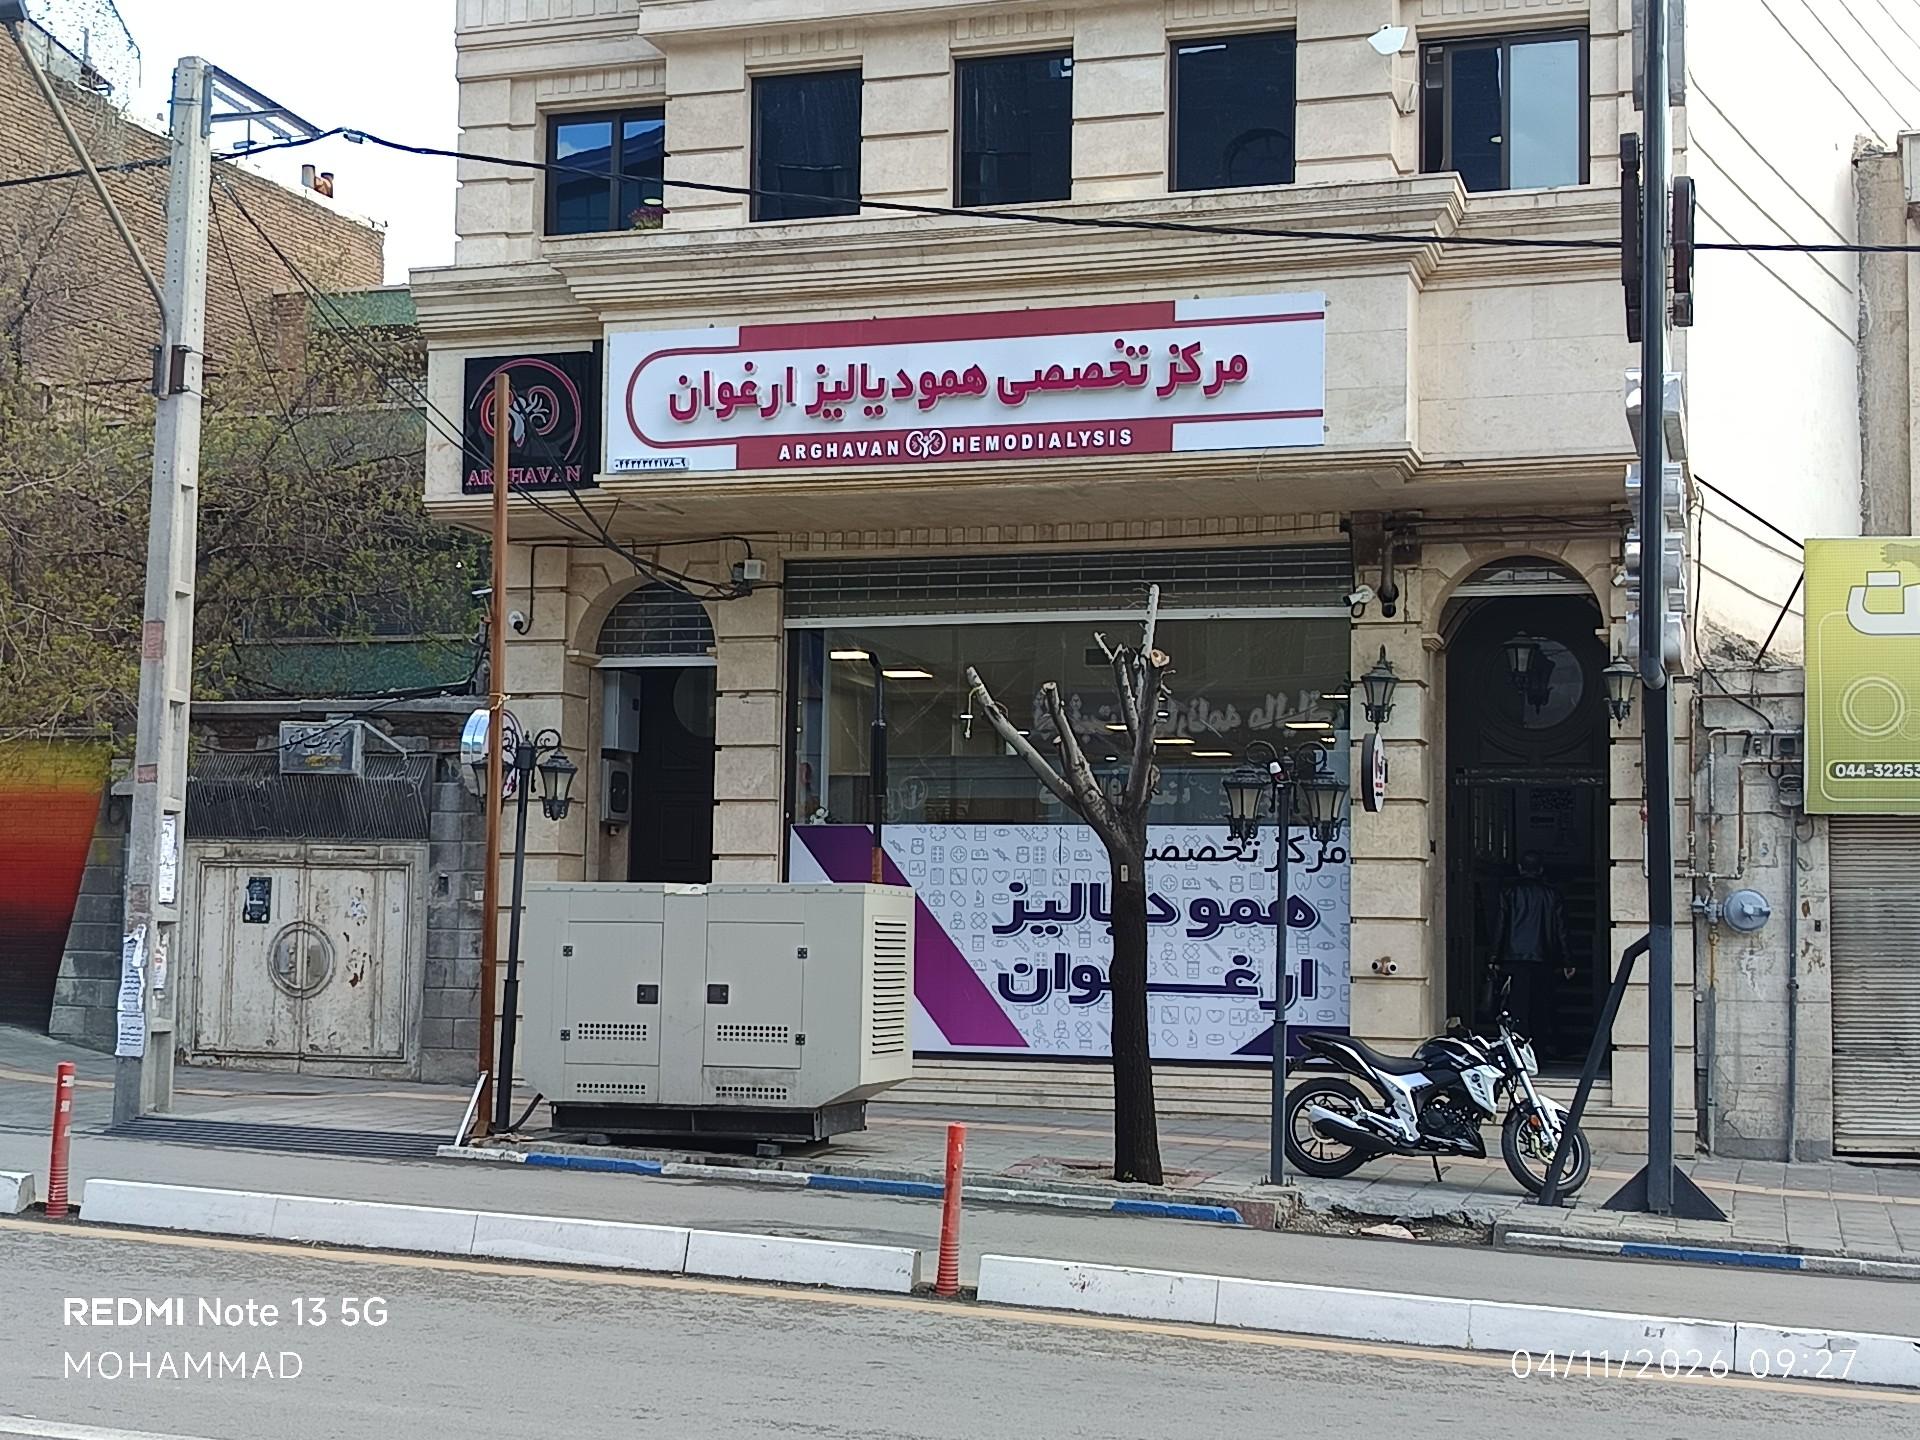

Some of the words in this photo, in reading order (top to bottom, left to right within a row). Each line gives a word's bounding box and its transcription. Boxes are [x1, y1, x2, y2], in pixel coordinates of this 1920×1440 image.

[669, 361, 794, 421] ارغوان
[997, 338, 1149, 405] تخصصی
[1155, 341, 1248, 398] مرکز
[778, 439, 899, 461] ARGHAVAN
[952, 428, 1132, 452] HEMODIALYSIS
[465, 464, 582, 486] ARHAVAN
[1144, 836, 1260, 862] تخصص
[1264, 835, 1347, 873] مرکز
[992, 882, 1318, 938] همودالیز
